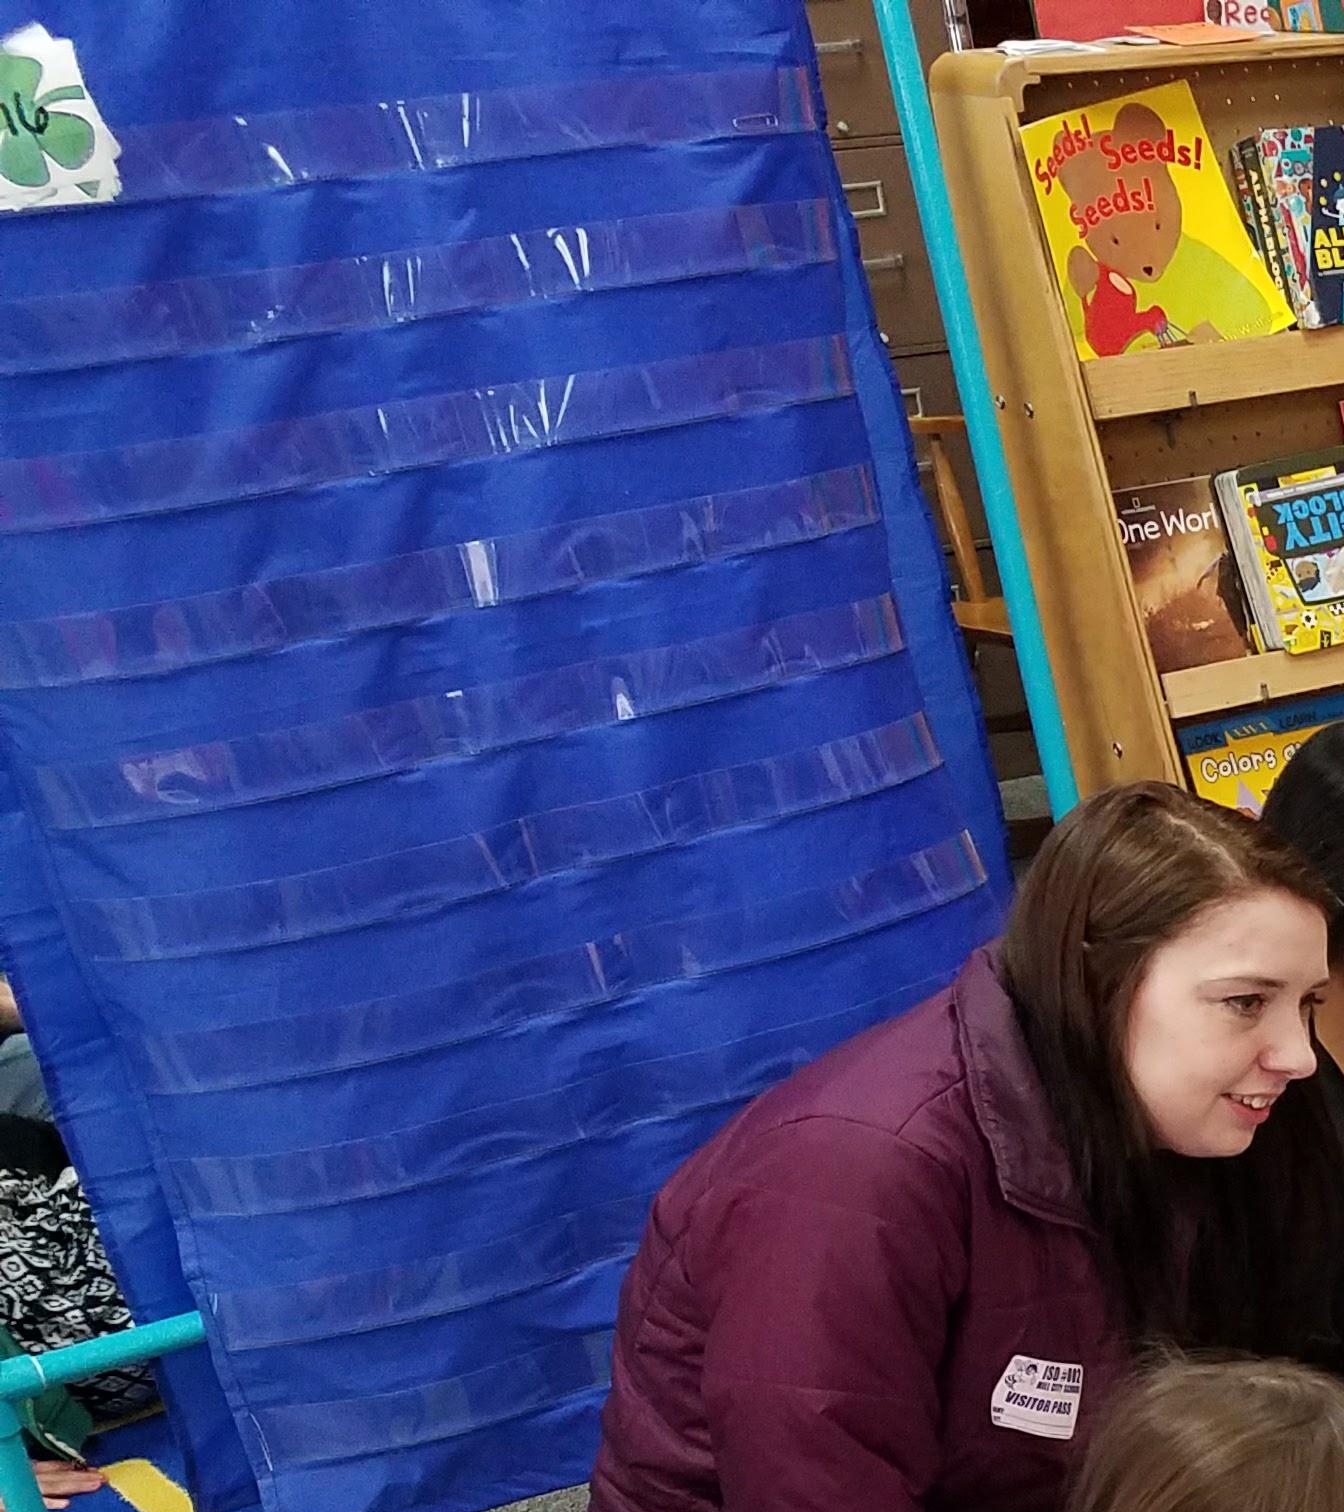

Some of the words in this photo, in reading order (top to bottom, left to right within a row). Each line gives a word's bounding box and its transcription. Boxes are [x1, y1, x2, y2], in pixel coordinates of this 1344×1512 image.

[1034, 113, 1094, 196] Seeds!
[1099, 129, 1203, 171] Seeds!
[1069, 177, 1155, 239] Seeds!
[1161, 503, 1219, 537] Worl
[1201, 749, 1278, 784] Colors
[1004, 1390, 1051, 1413] VISITOR
[1051, 1400, 1072, 1415] PASS
